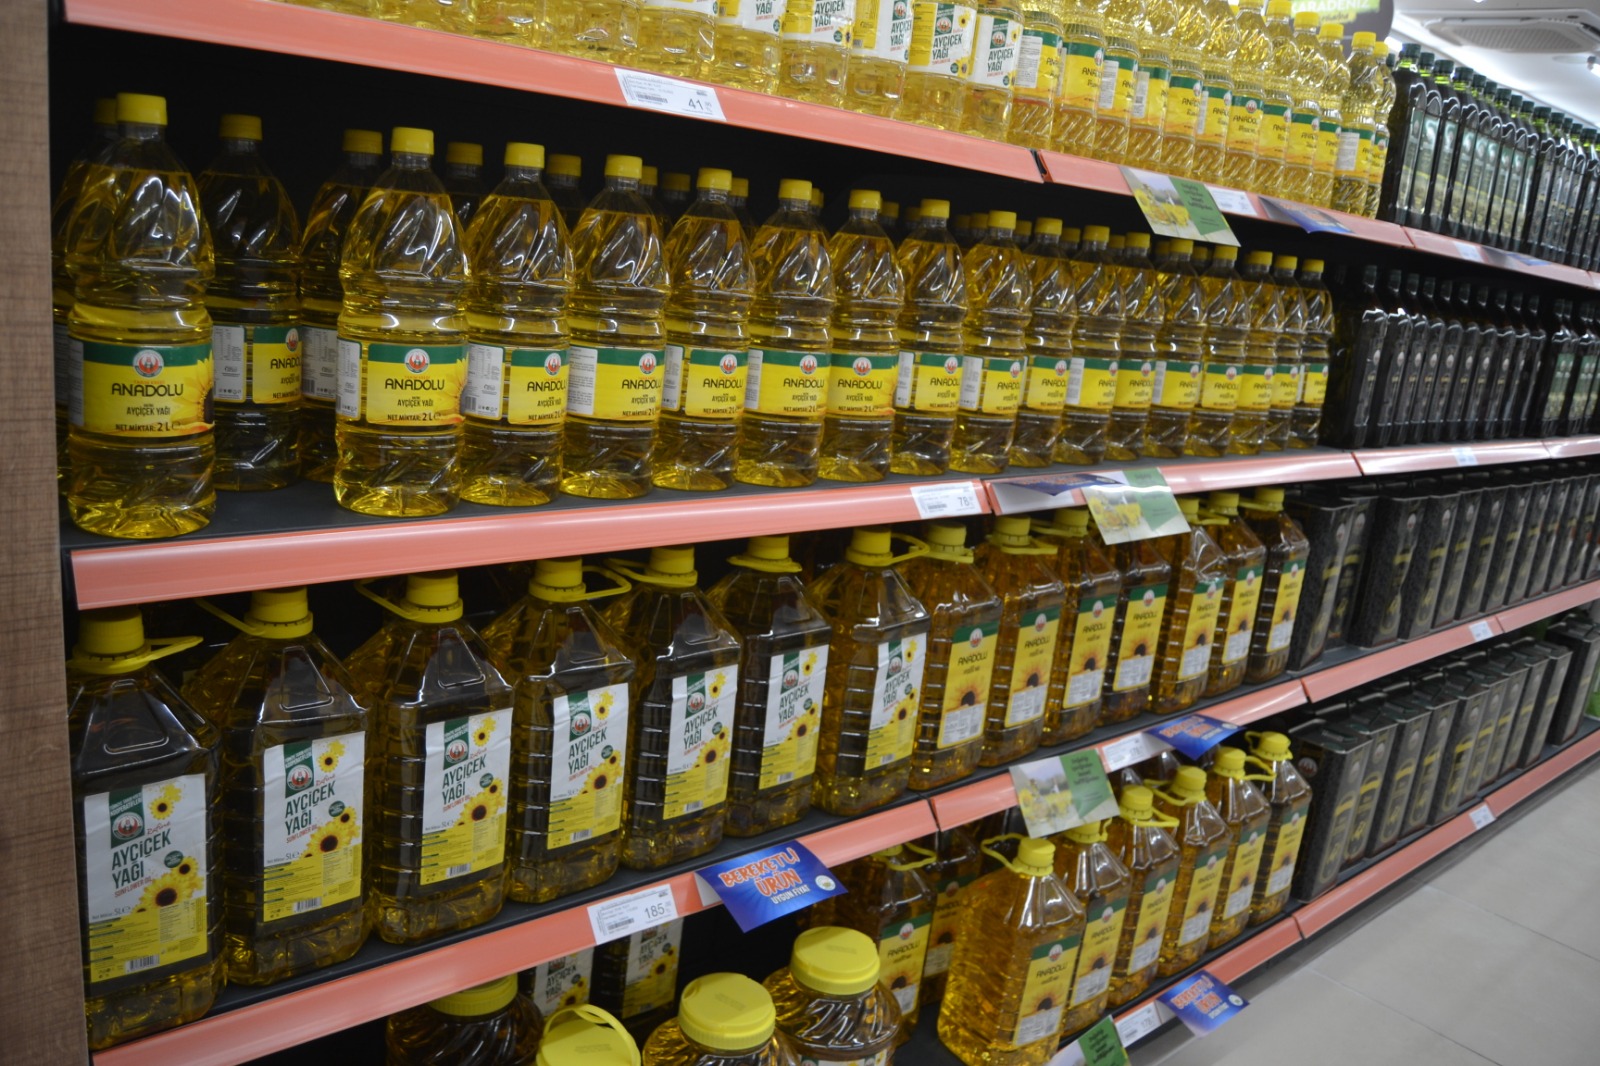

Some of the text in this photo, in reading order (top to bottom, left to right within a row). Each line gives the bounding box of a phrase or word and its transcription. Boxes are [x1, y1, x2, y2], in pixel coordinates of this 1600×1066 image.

[112, 382, 184, 397] ANADOLU
[385, 378, 445, 391] ANADOLU
[837, 378, 882, 389] ANADOLU
[126, 406, 155, 416] AYÇİÇEK
[422, 412, 428, 421] 2
[115, 424, 127, 432] NET
[157, 422, 164, 432] 2
[569, 726, 608, 760] AYÇİÇEK
[442, 753, 487, 790] AYÇİÇEK
[284, 780, 336, 818] AYÇİÇEK
[442, 780, 466, 806] YAĞI
[284, 809, 312, 836] YAĞI
[111, 828, 172, 870] AYÇİÇEK
[112, 860, 145, 890] YAĞI
[754, 867, 803, 897] ÜRÜN
[645, 902, 665, 920] 185
